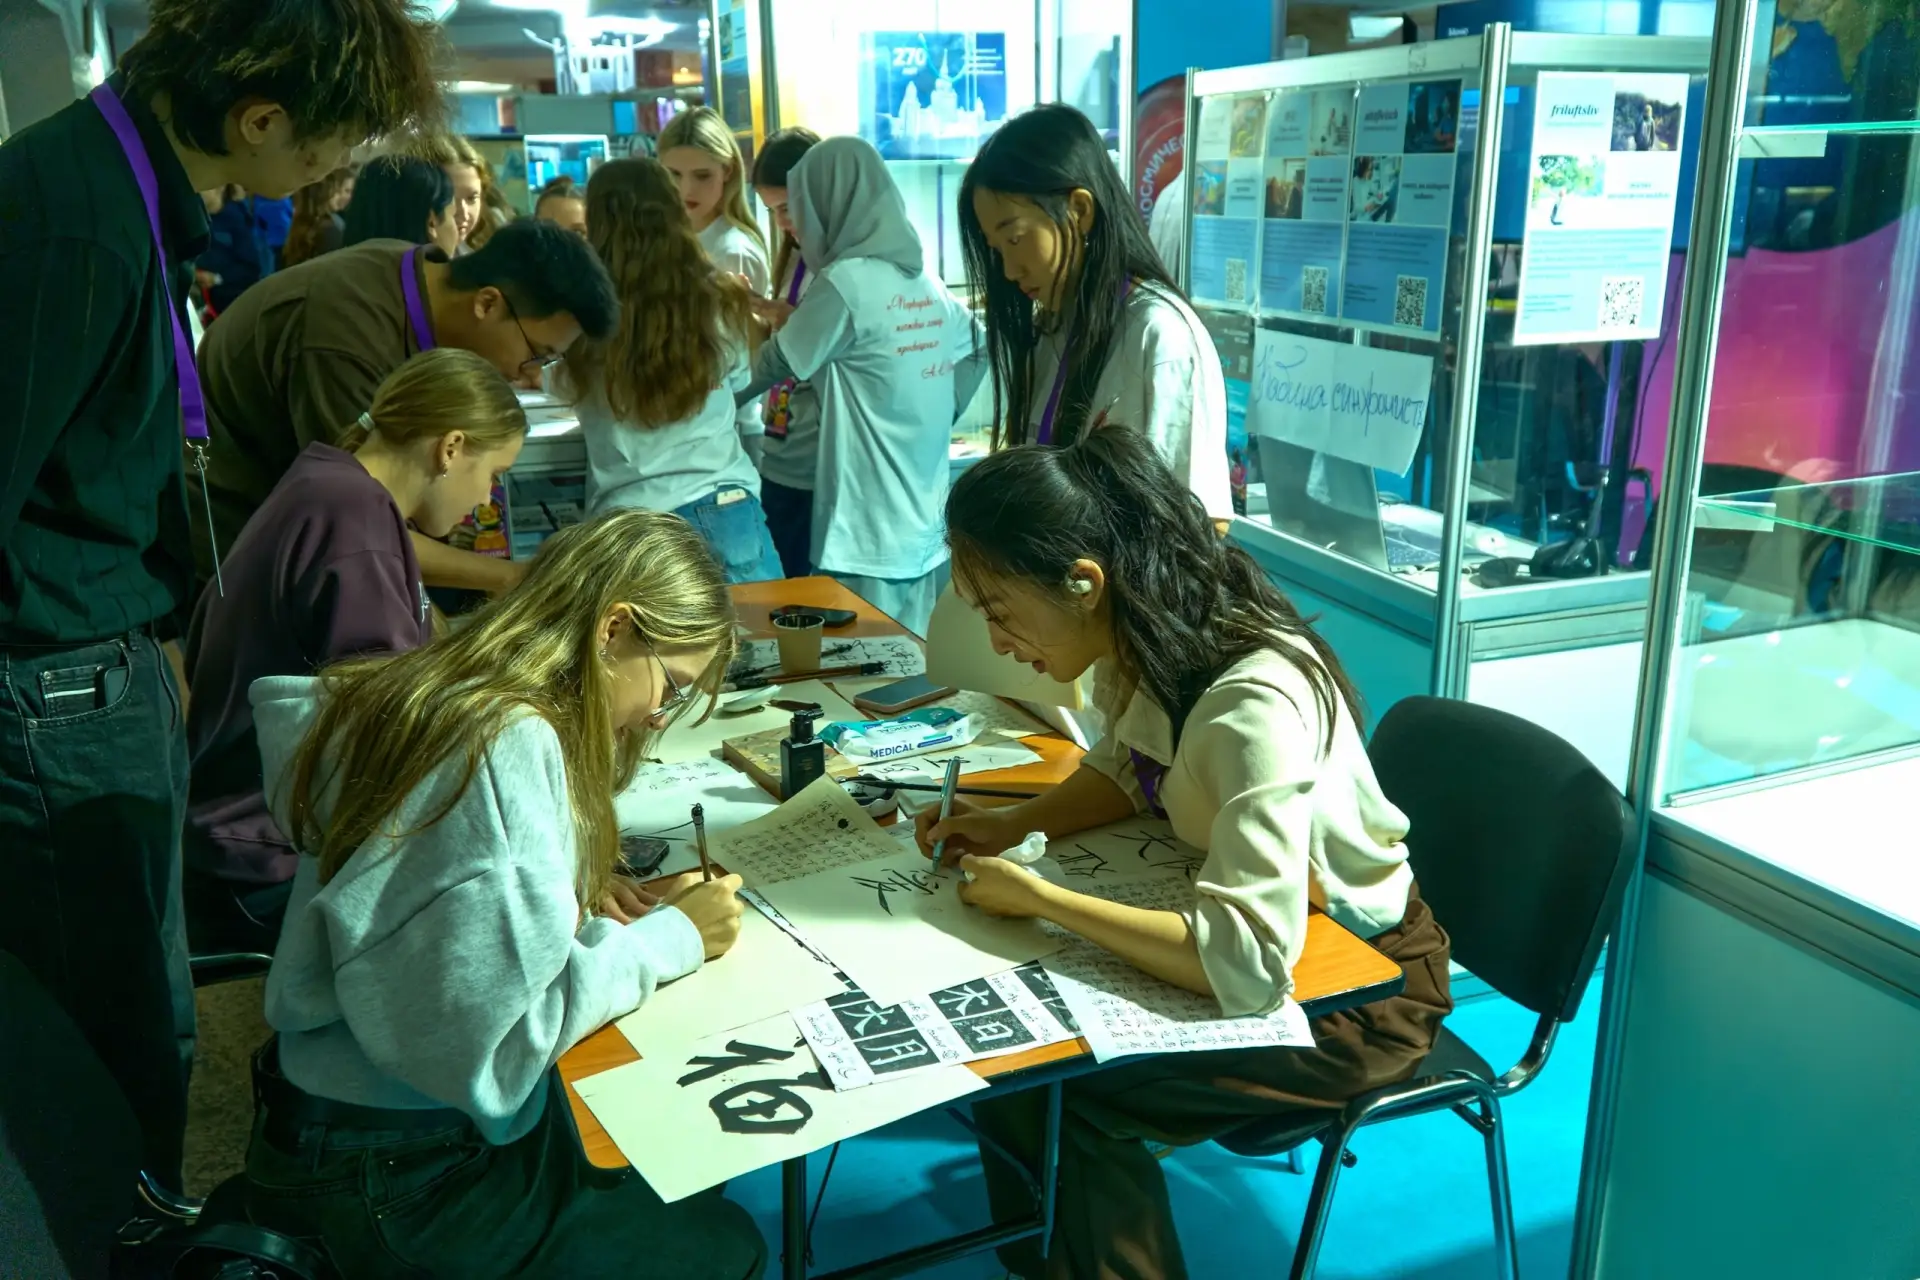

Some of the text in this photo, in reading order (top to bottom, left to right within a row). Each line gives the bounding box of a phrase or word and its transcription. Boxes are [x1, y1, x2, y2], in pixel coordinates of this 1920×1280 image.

[893, 47, 925, 67] 270
[1550, 102, 1600, 118] friluftsliv
[869, 743, 915, 759] MEDICAL
[972, 1021, 1014, 1045] 日
[861, 1038, 929, 1067] 月
